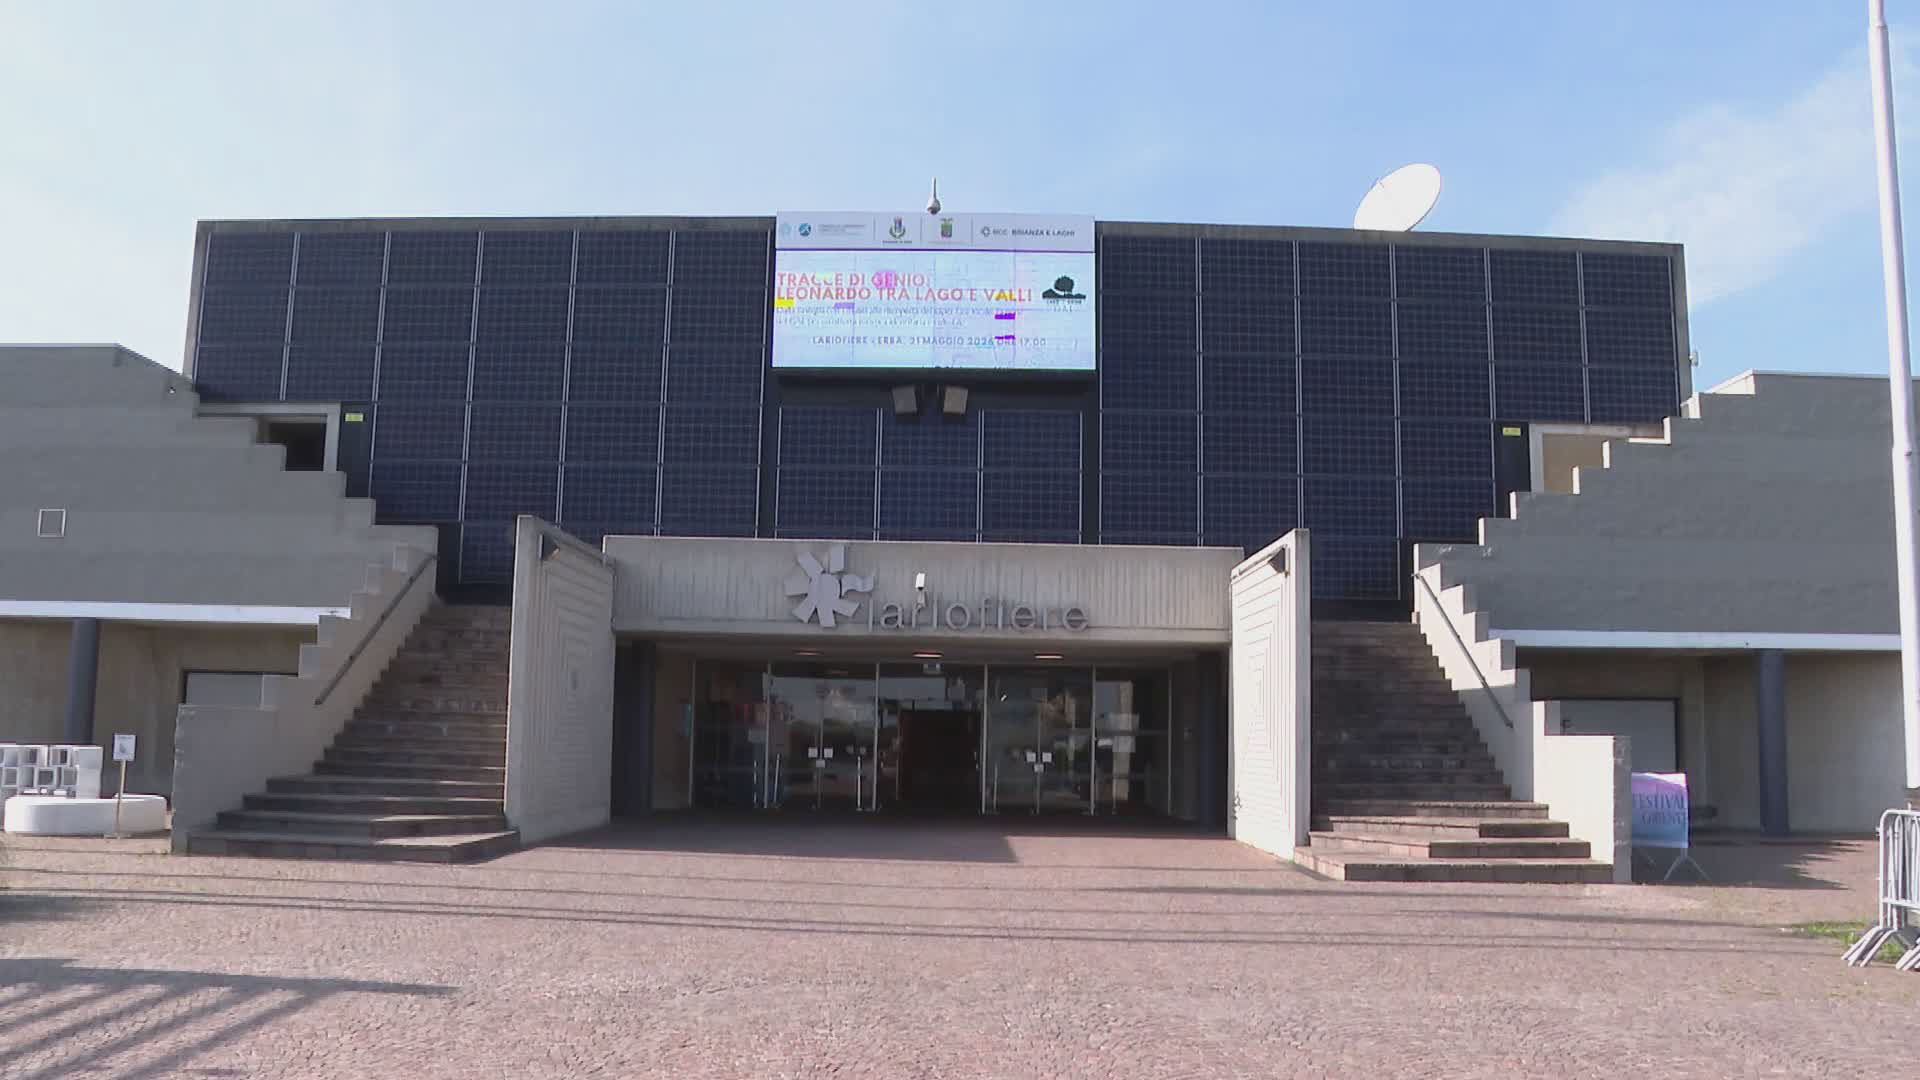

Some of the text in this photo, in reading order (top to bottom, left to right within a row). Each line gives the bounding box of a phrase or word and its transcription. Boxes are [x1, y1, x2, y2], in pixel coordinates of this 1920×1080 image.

[849, 273, 866, 287] DI
[776, 287, 1032, 303] LEONARDO TRA LAGO E VALLI
[921, 336, 965, 346] MAGGIO
[867, 595, 1089, 632] lariofiere
